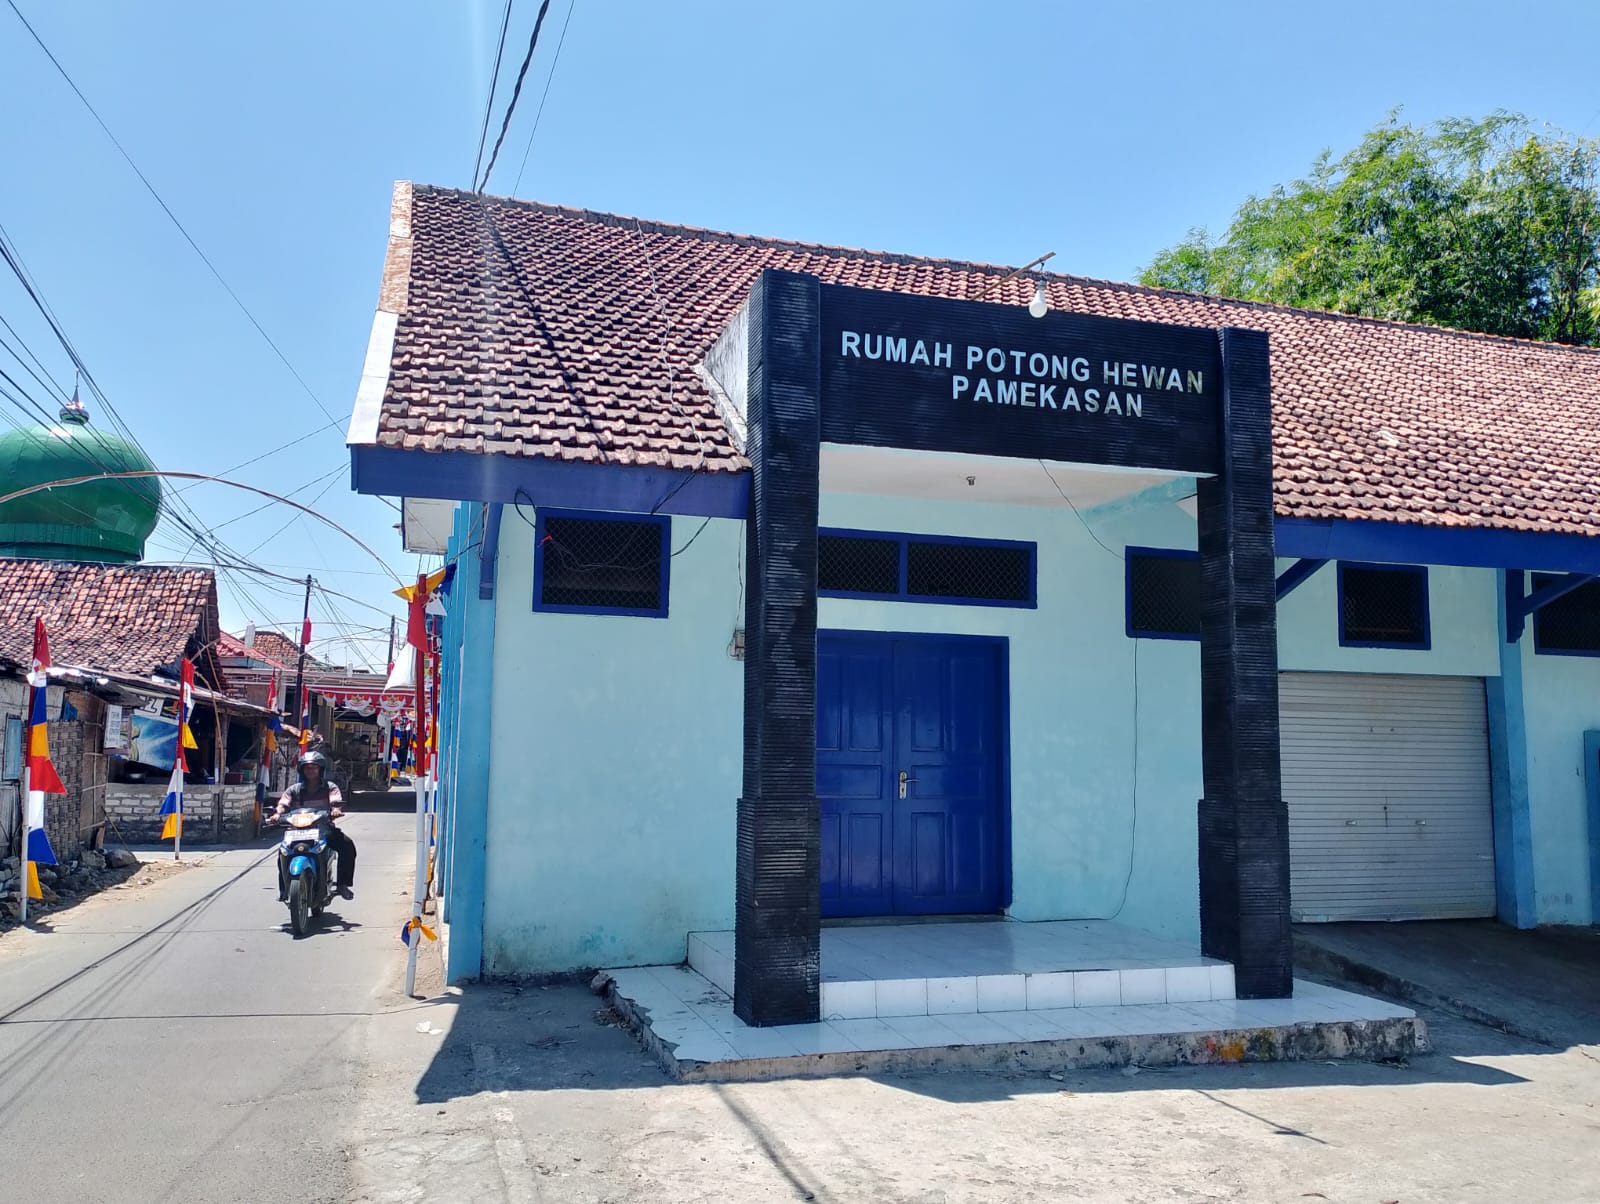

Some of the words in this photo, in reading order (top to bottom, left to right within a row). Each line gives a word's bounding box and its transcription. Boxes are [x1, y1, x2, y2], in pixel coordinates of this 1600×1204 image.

[841, 330, 952, 368] RUMAH
[966, 345, 1090, 382] POTONG
[1103, 360, 1203, 394] HEWAN
[952, 375, 1142, 418] PAMEKASAN
